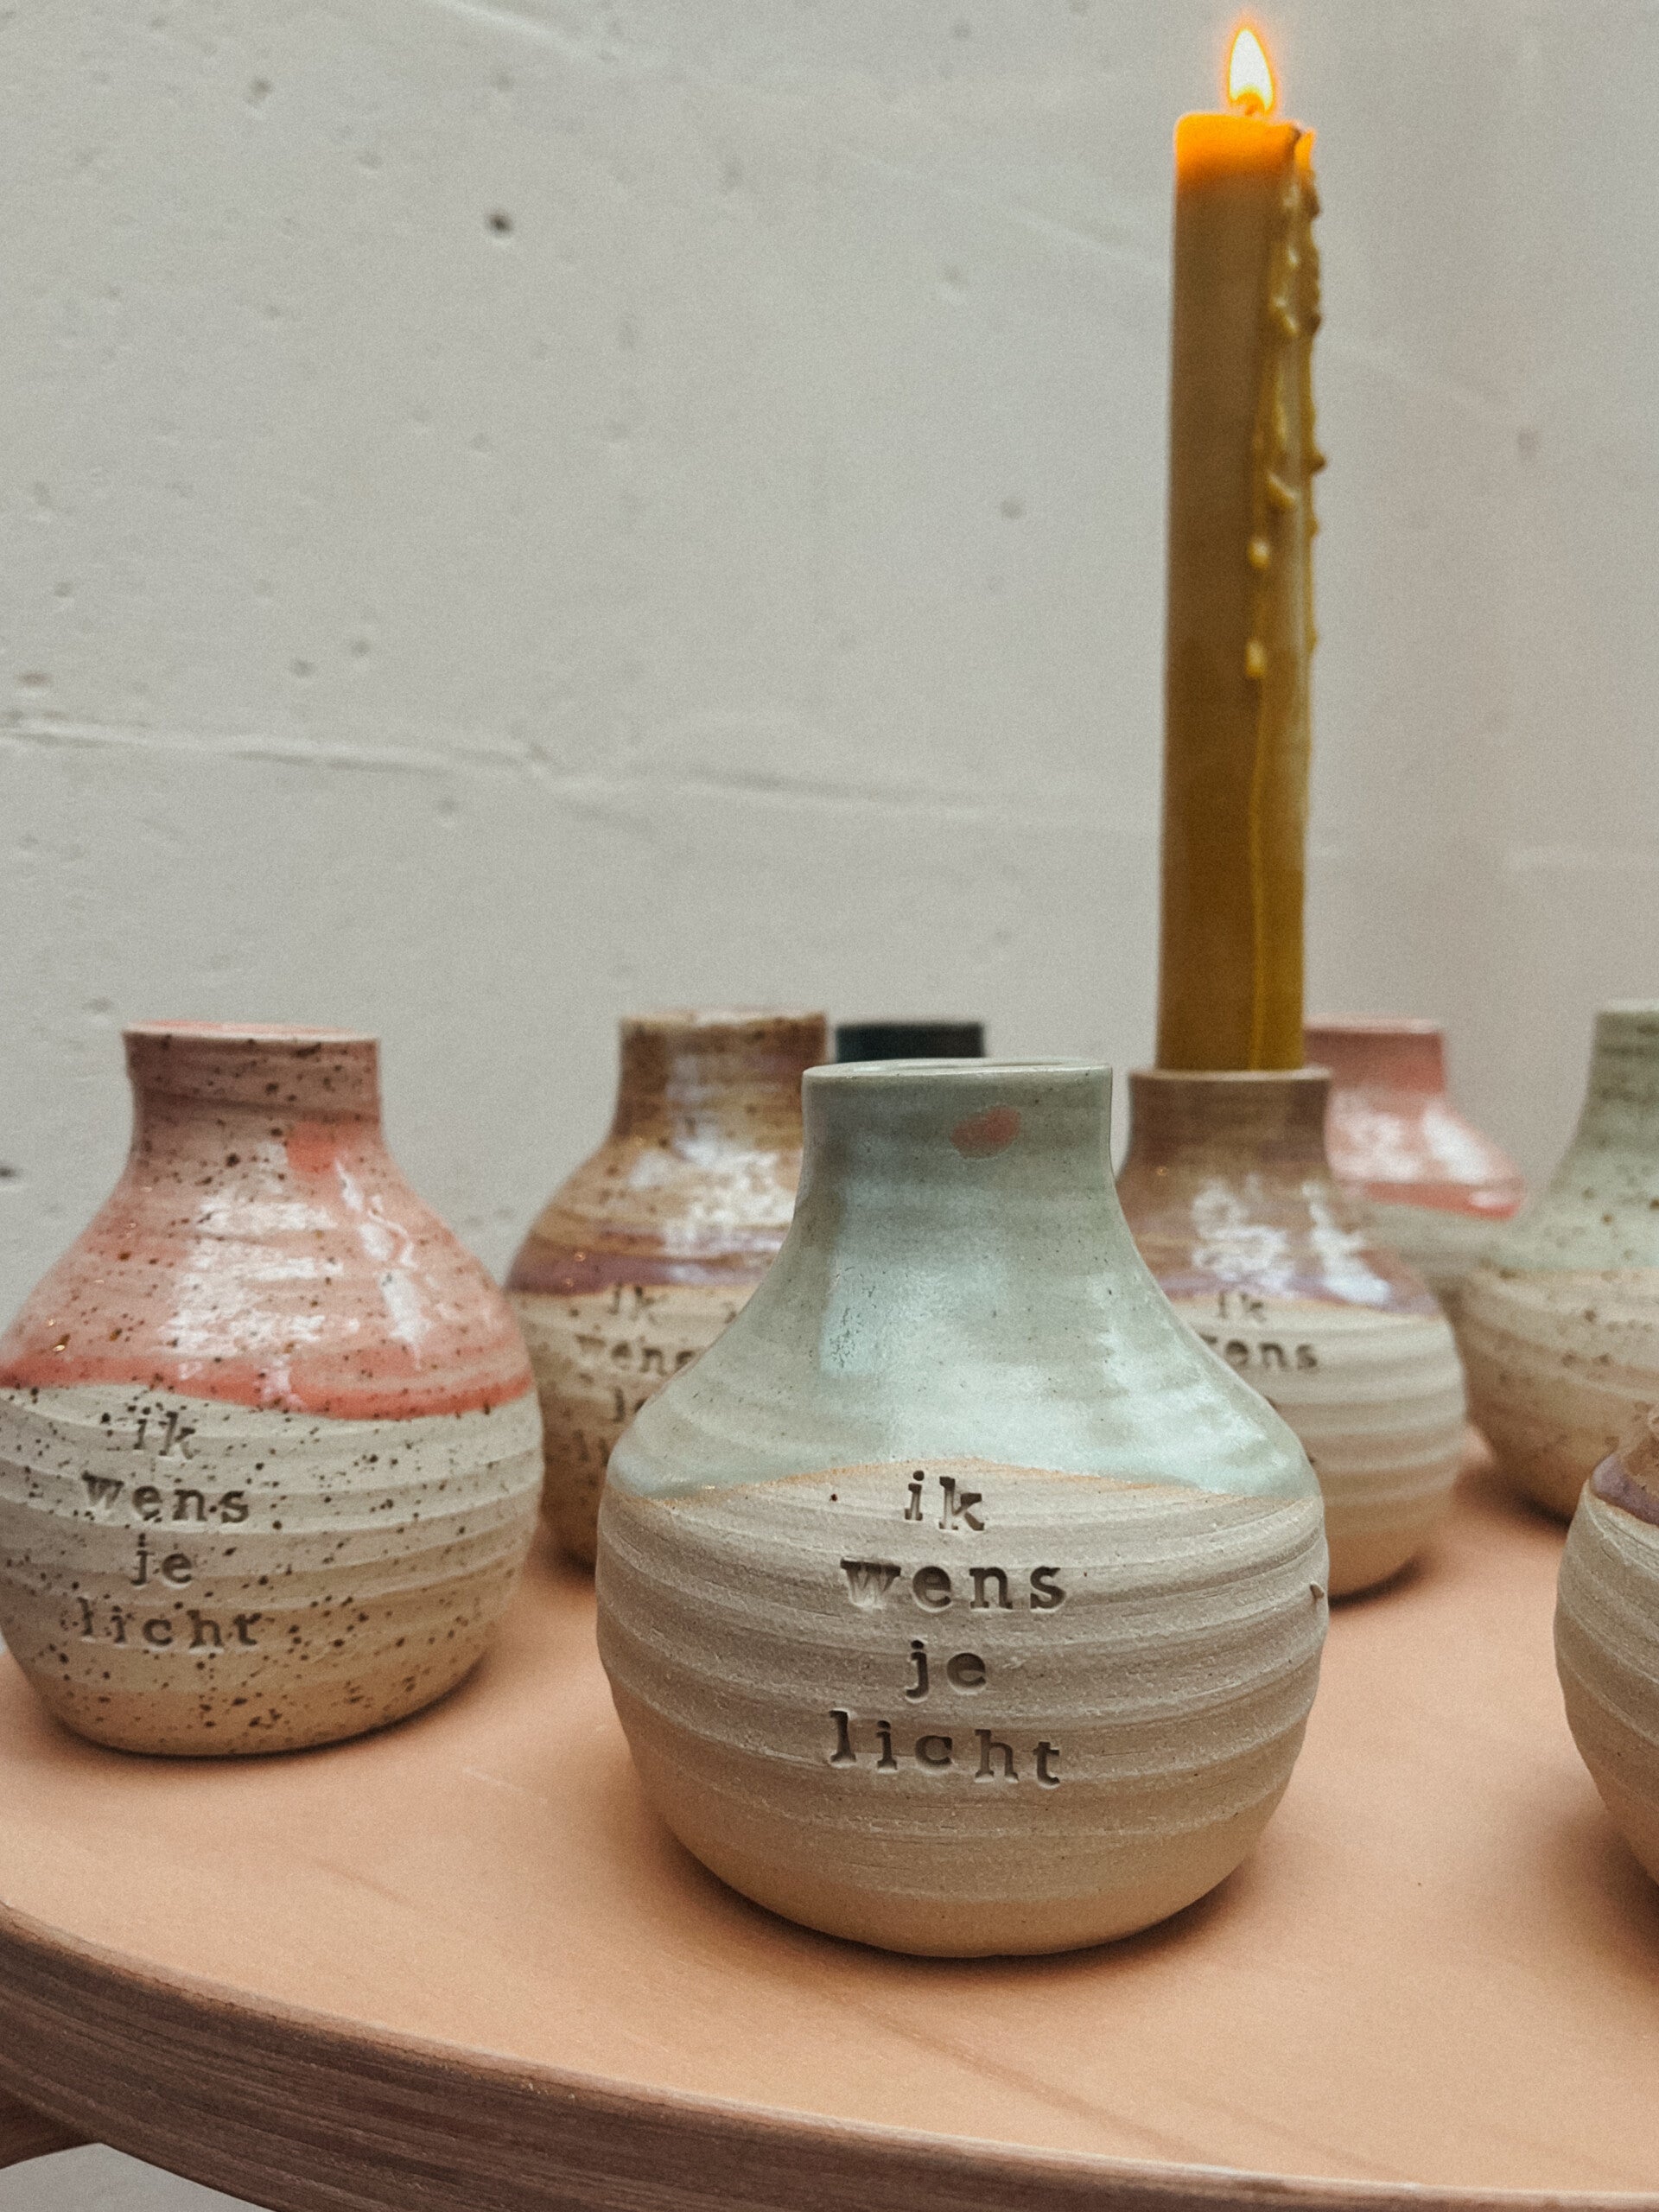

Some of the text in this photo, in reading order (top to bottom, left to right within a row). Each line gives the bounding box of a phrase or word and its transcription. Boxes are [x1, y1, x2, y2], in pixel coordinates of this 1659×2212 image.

[1198, 1332, 1319, 1374] ens
[133, 1406, 196, 1459] ik
[81, 1471, 250, 1524] wens
[904, 1470, 985, 1531] ik
[130, 1532, 194, 1586] je
[839, 1557, 1067, 1611] wens
[78, 1598, 263, 1649] licht
[905, 1639, 987, 1701] je
[828, 1709, 1061, 1787] licht
